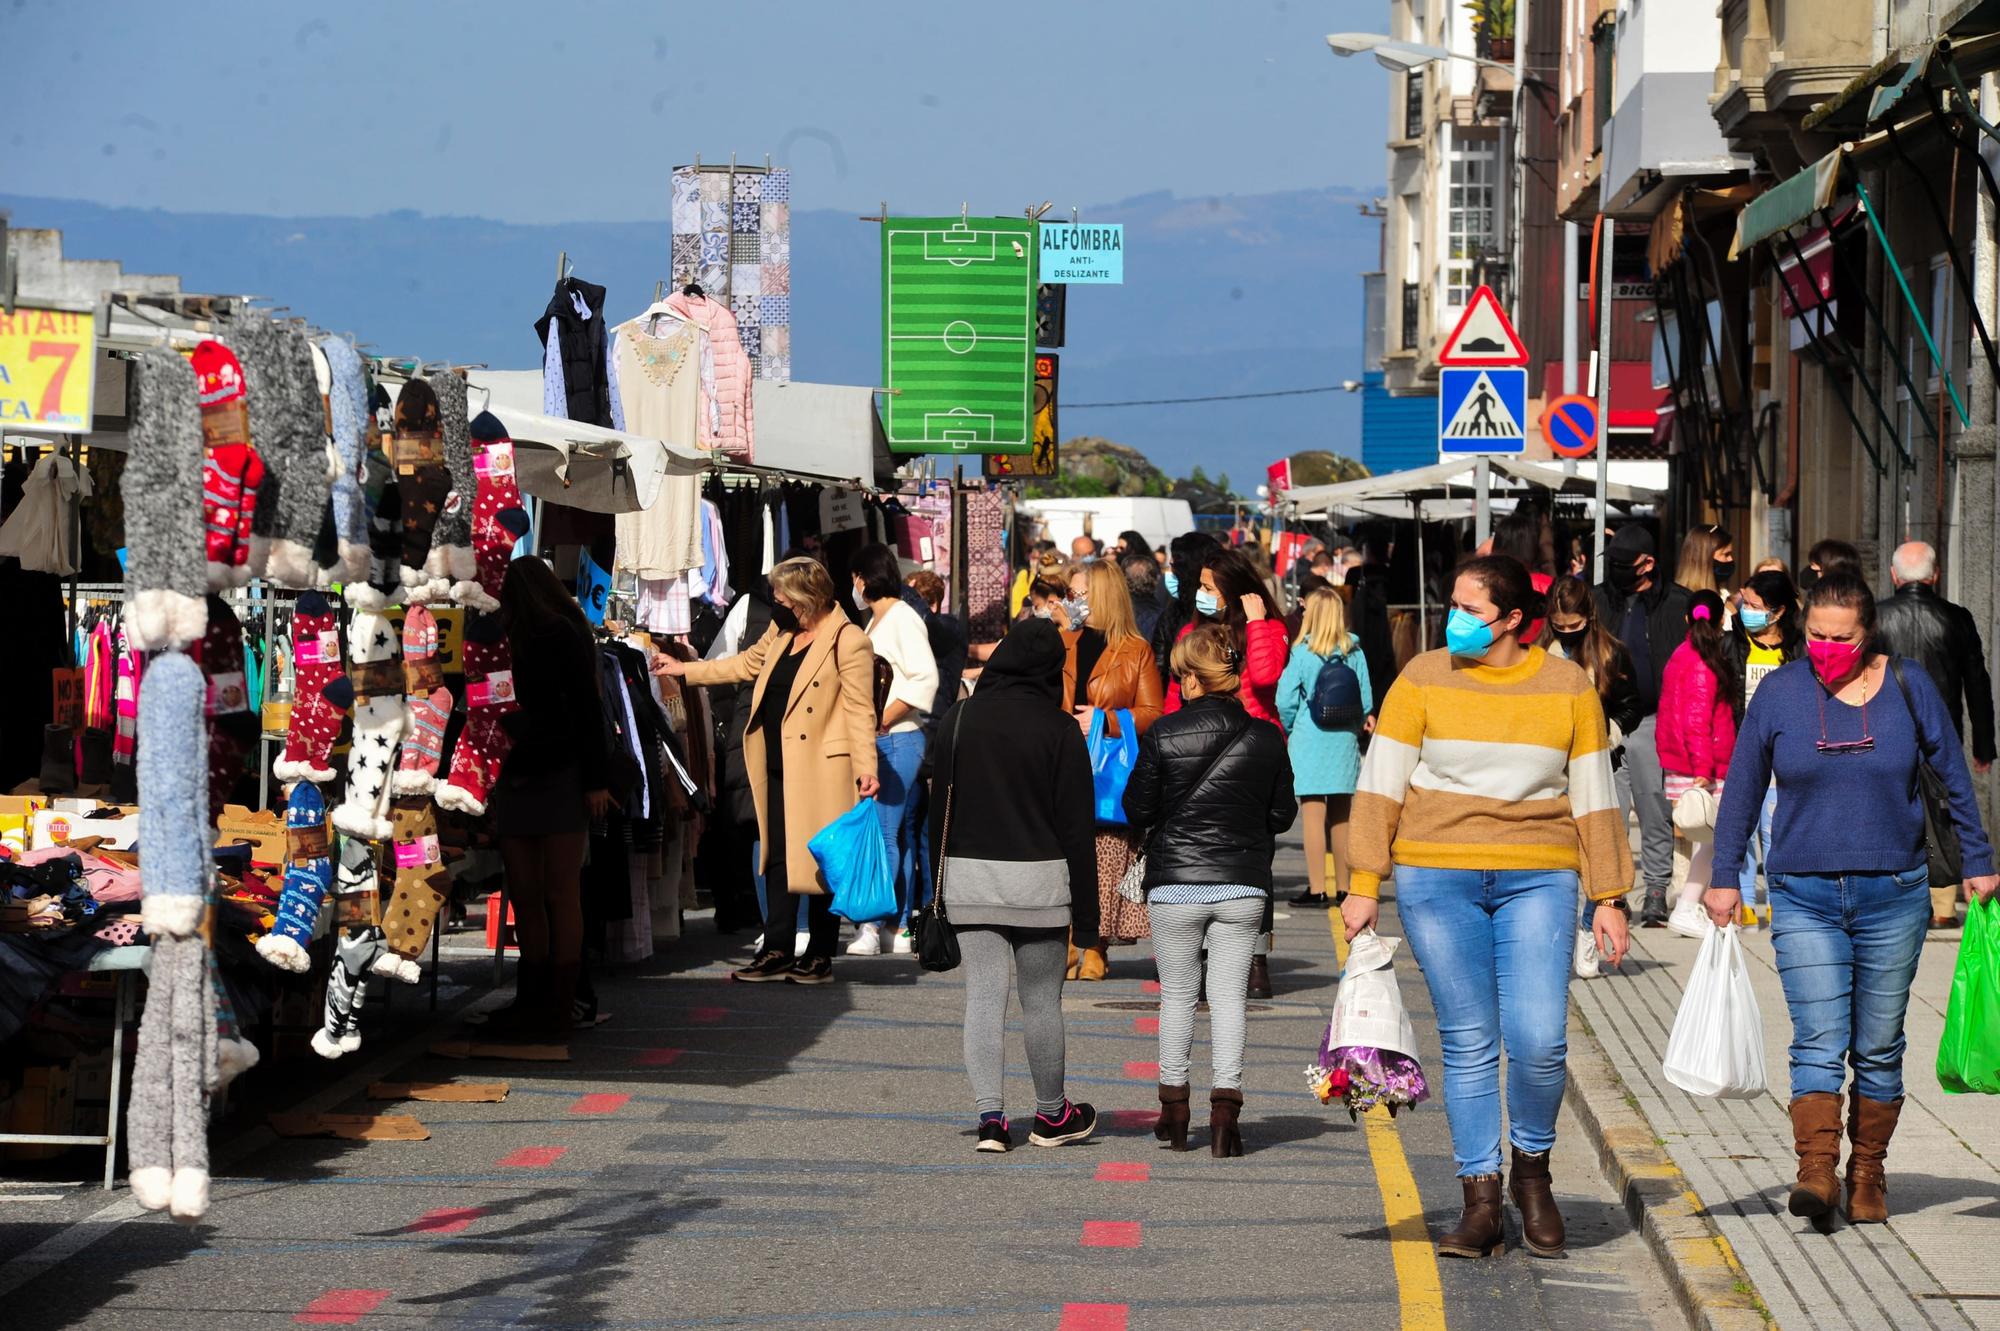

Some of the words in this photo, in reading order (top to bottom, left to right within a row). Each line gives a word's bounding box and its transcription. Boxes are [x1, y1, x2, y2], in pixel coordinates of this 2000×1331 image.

[1043, 229, 1121, 250] ALFOMBRA
[1070, 256, 1095, 264] ANTI-
[1054, 270, 1110, 278] DESLIZANTE
[28, 340, 80, 421] 7
